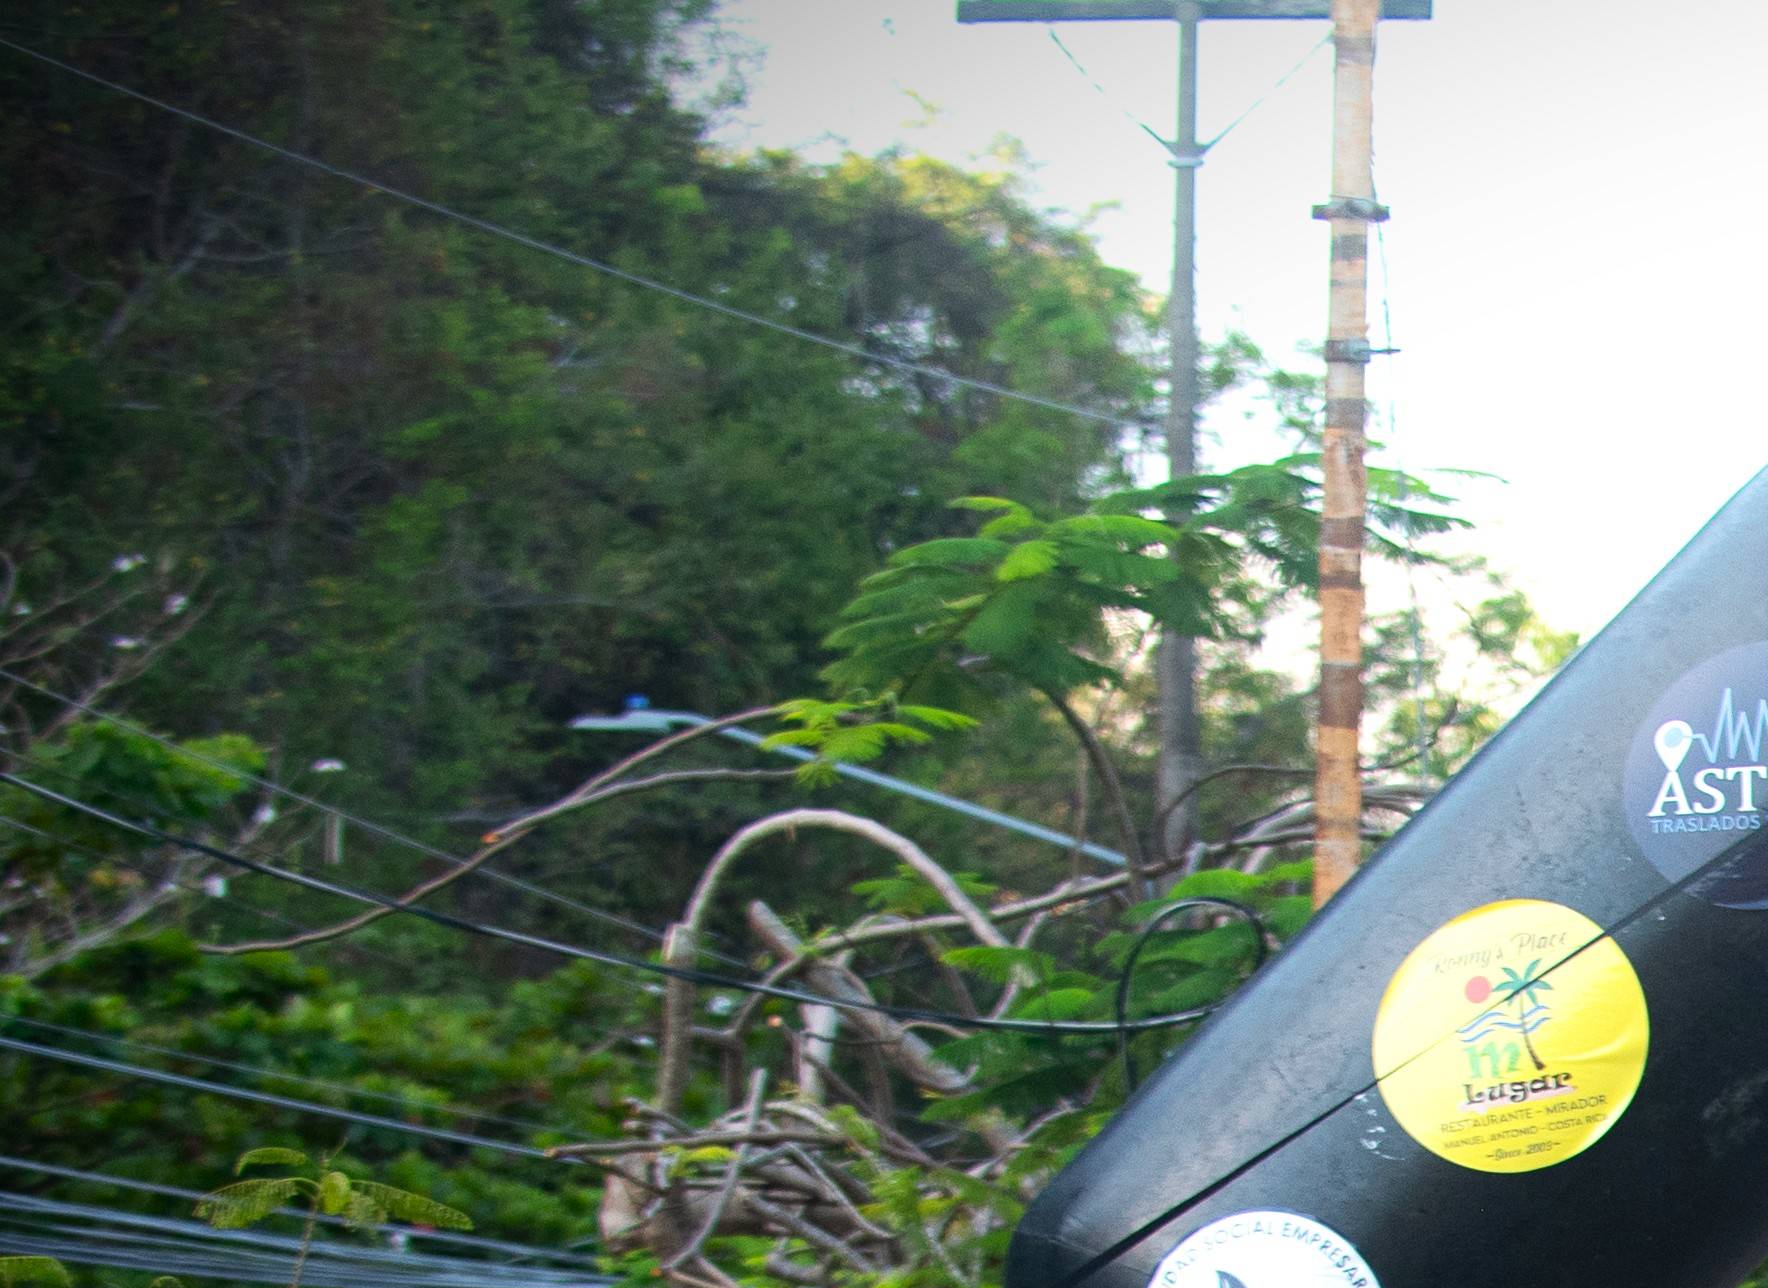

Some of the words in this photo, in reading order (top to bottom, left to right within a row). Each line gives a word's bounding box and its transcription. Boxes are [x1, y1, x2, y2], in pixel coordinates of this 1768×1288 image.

[1651, 815, 1761, 835] TRASLADOS
[1462, 1071, 1574, 1106] Lugar
[1440, 1107, 1534, 1134] RESTAURANTE
[1544, 1094, 1609, 1115] MIRADOR
